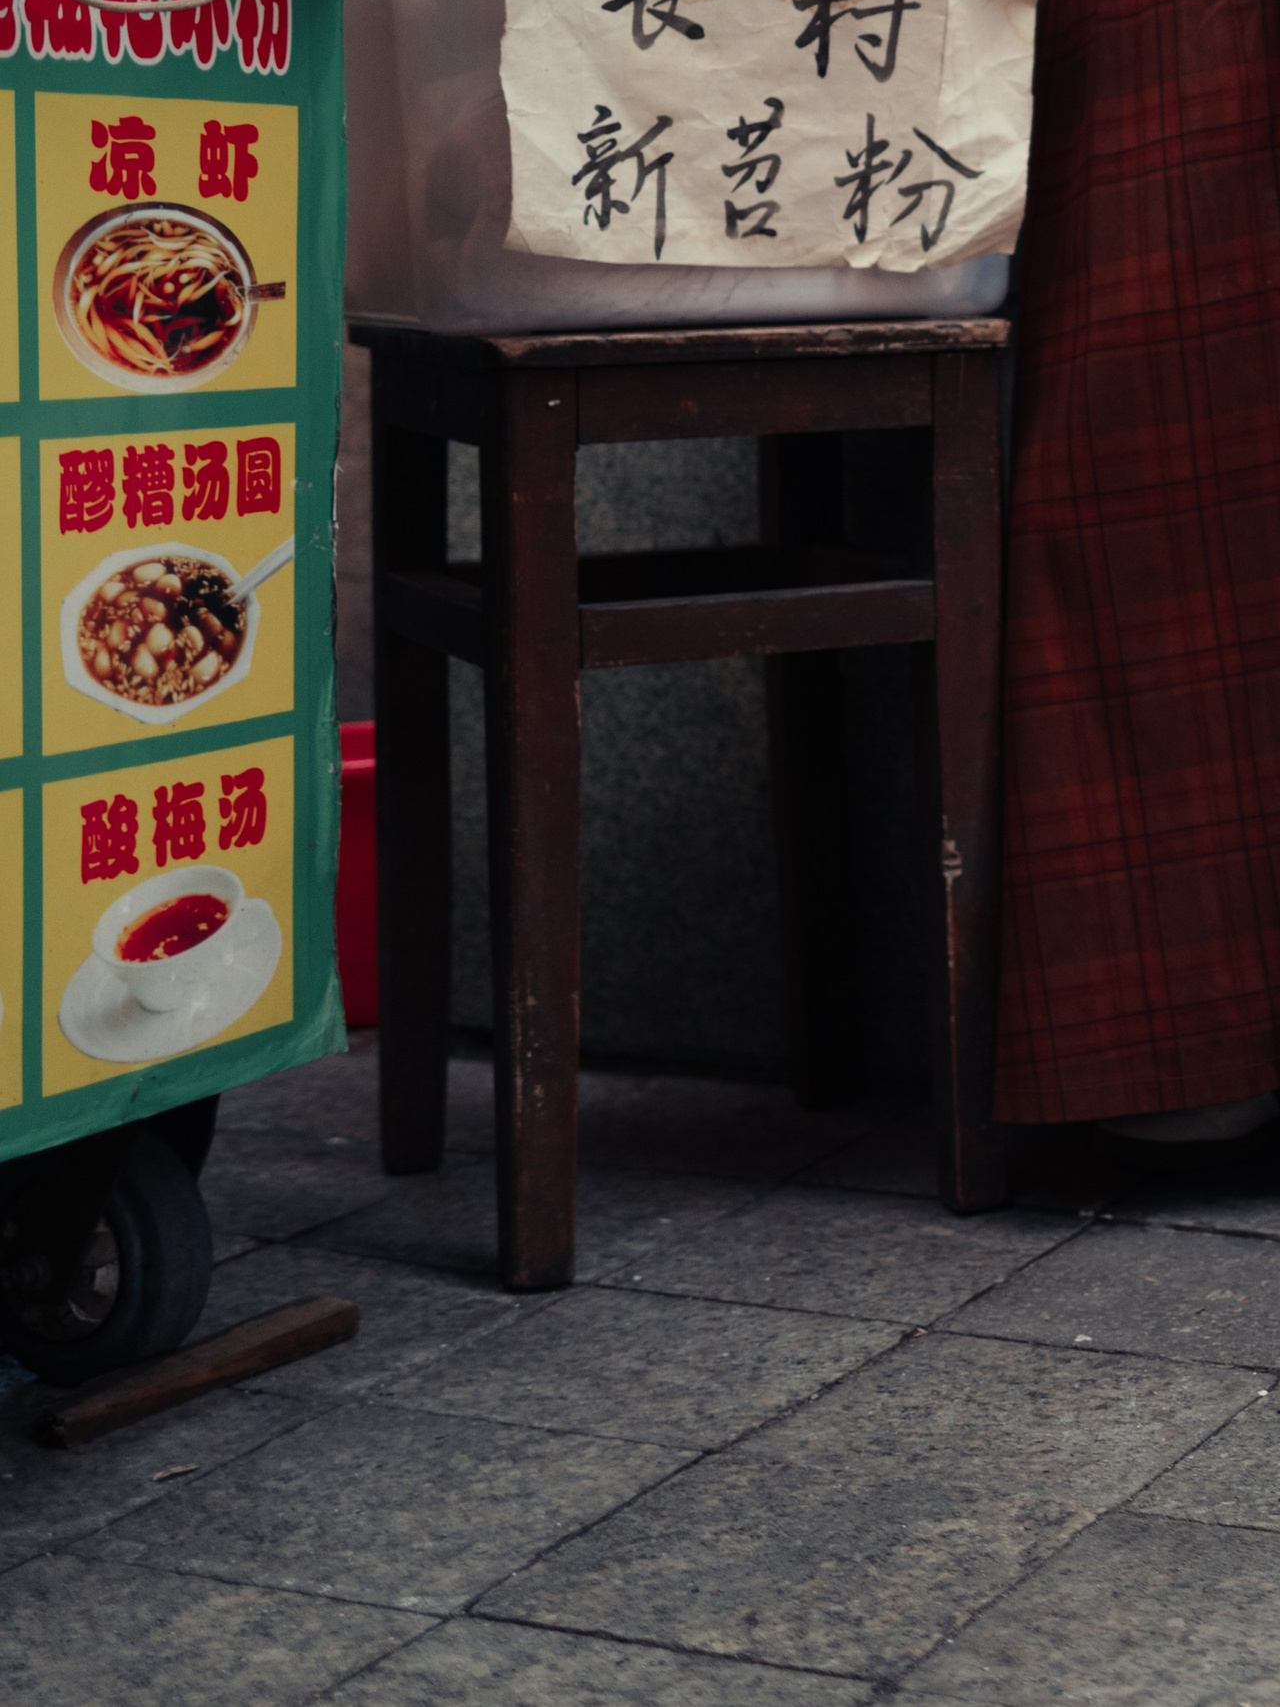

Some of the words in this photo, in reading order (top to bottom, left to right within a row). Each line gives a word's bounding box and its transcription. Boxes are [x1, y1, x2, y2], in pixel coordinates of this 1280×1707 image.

[89, 115, 259, 202] 凉虾
[571, 97, 985, 261] 新苕粉
[58, 436, 281, 535] 醪糟汤圆
[80, 767, 267, 884] 酸梅汤
